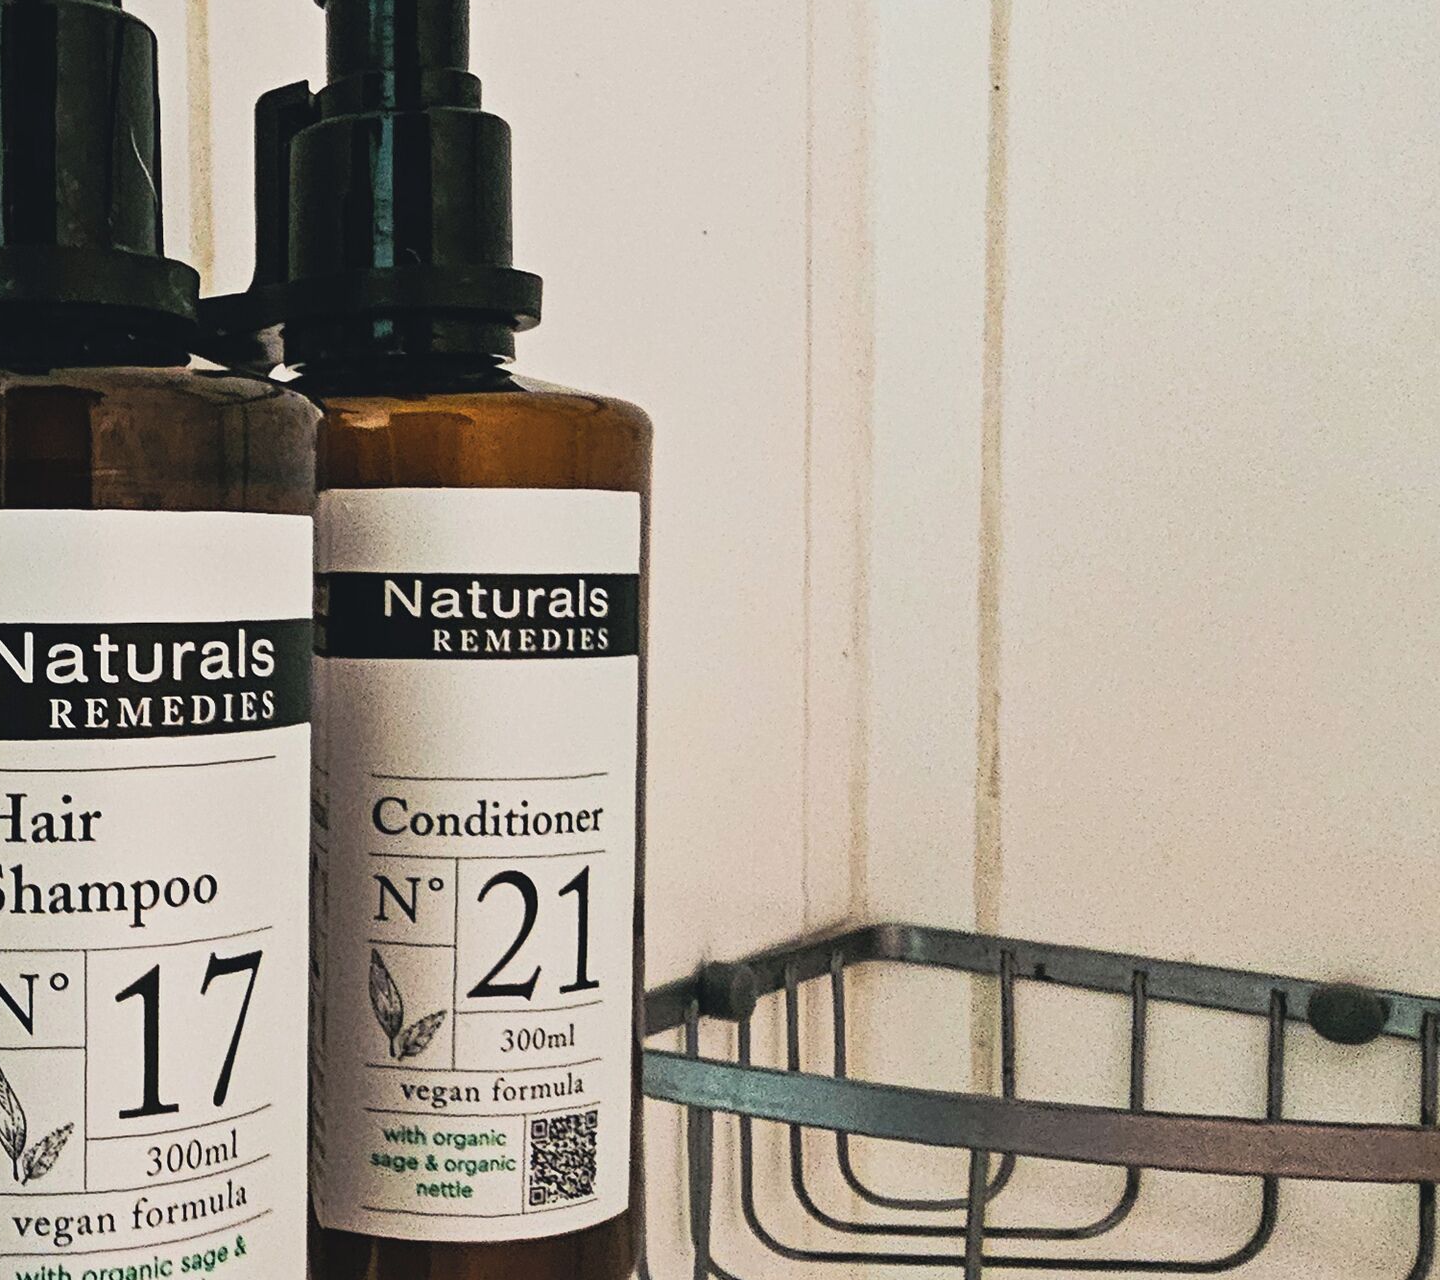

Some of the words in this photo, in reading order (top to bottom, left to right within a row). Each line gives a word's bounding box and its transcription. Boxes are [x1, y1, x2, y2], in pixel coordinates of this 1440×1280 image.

[383, 579, 609, 618] Naturals
[433, 627, 609, 652] REMEDIES
[49, 689, 275, 729] REMEDIES
[372, 796, 603, 837] Conditioner
[467, 865, 599, 1001] 21
[115, 949, 263, 1119] 17
[500, 1023, 575, 1052] 300ml
[400, 1082, 480, 1109] vegan
[492, 1072, 584, 1102] formula
[146, 1129, 239, 1177] 300ml
[383, 1124, 427, 1146] with
[433, 1129, 507, 1150] organic
[370, 1152, 419, 1173] sage
[425, 1154, 438, 1171] &
[444, 1155, 516, 1176] organic
[416, 1181, 474, 1199] nettle
[12, 1214, 116, 1247] vegan
[131, 1181, 248, 1231] formula
[180, 1245, 229, 1273] sage
[234, 1234, 247, 1257] &
